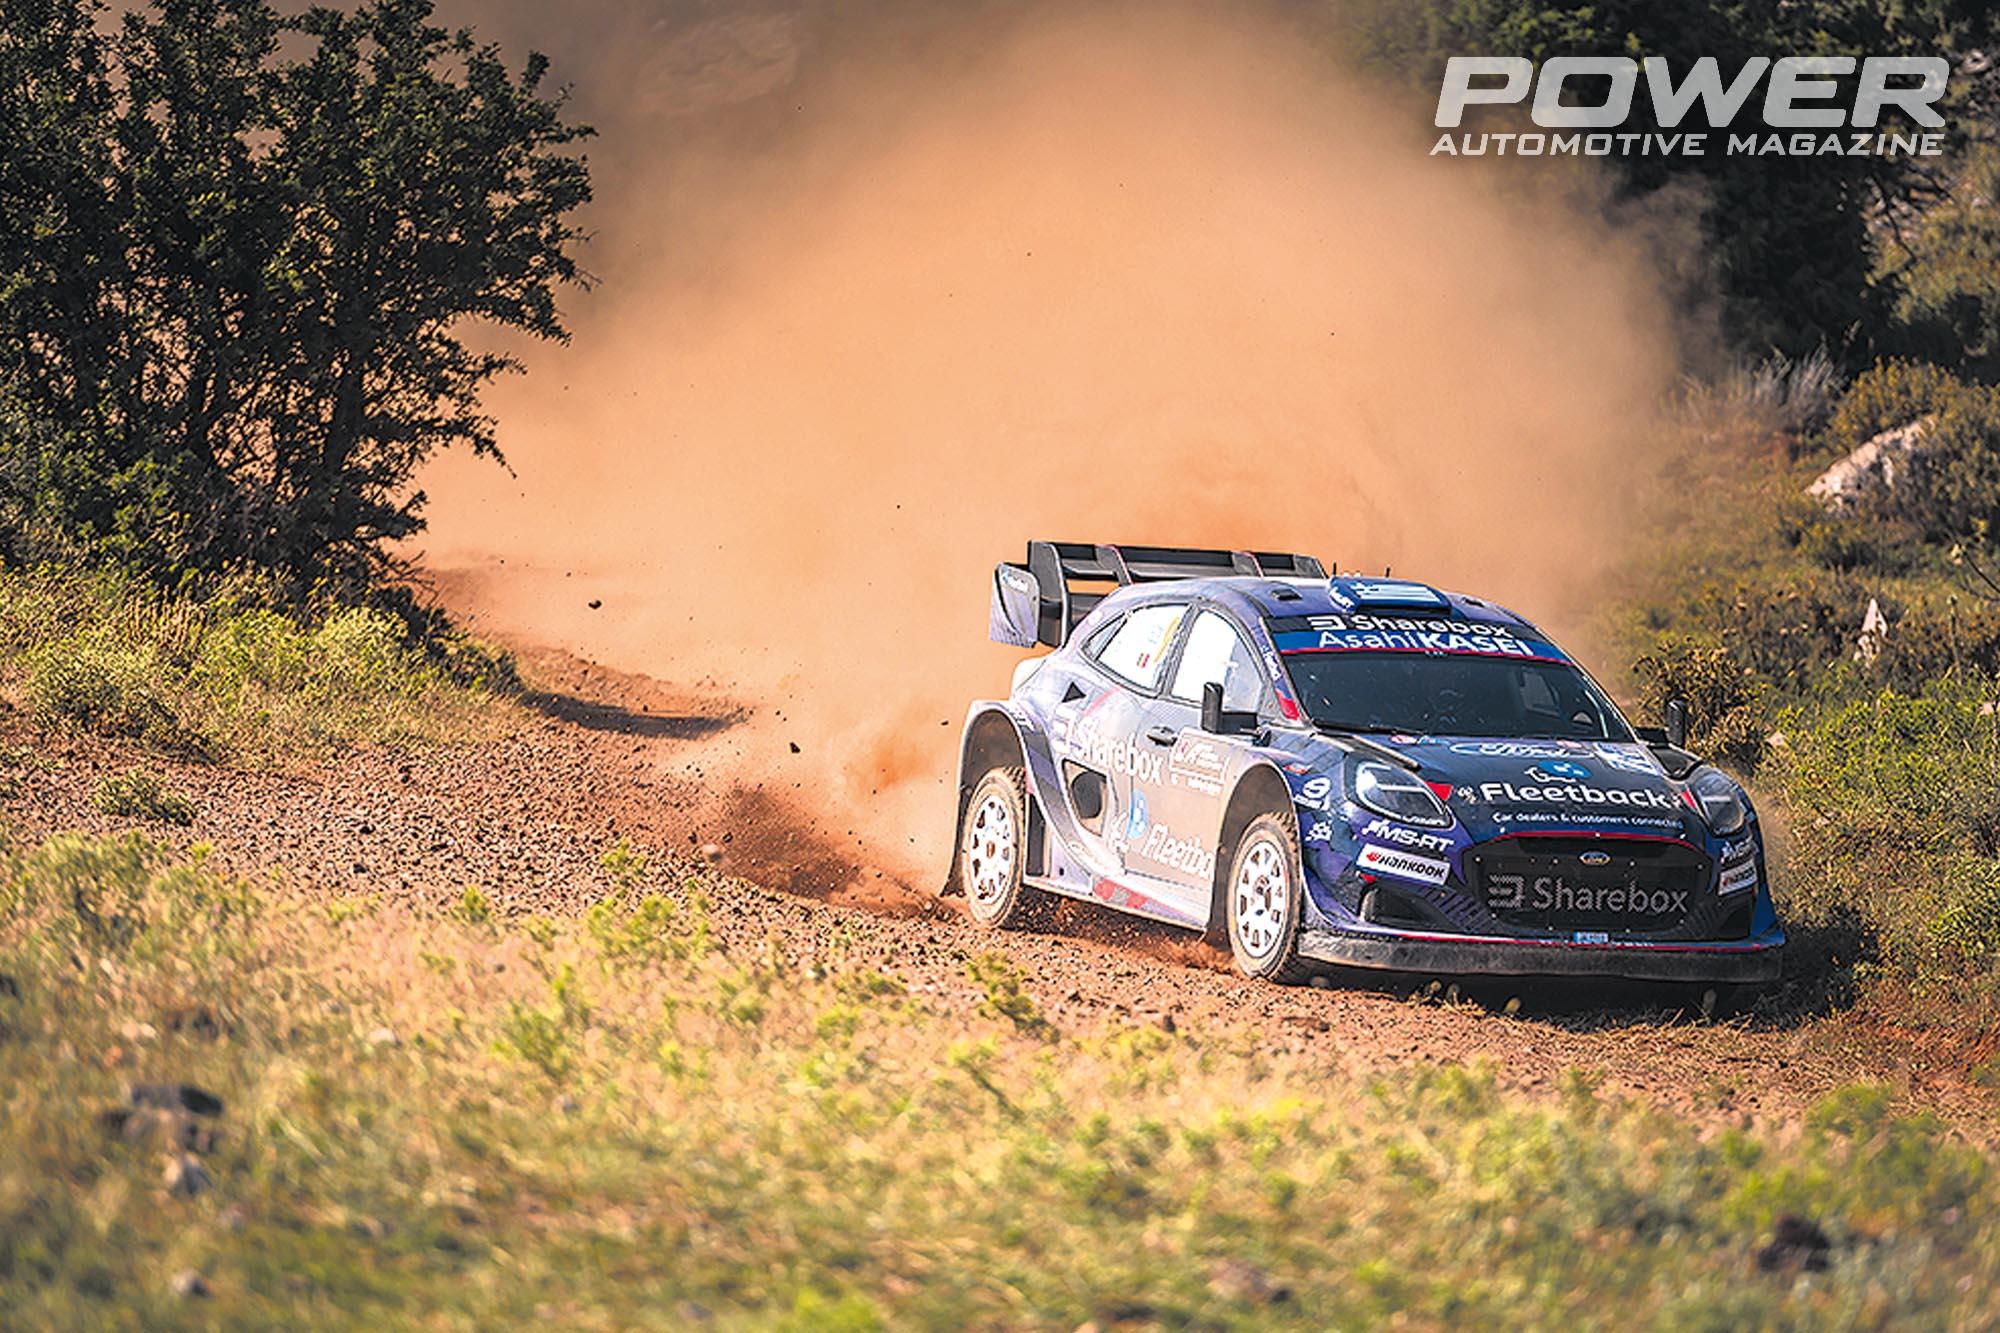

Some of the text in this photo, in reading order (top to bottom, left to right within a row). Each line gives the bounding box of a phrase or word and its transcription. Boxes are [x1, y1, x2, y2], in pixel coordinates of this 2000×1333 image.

[1350, 614, 1514, 640] Sharebox
[1479, 783, 1671, 809] Fleetback
[1532, 877, 1688, 914] Sharebox
